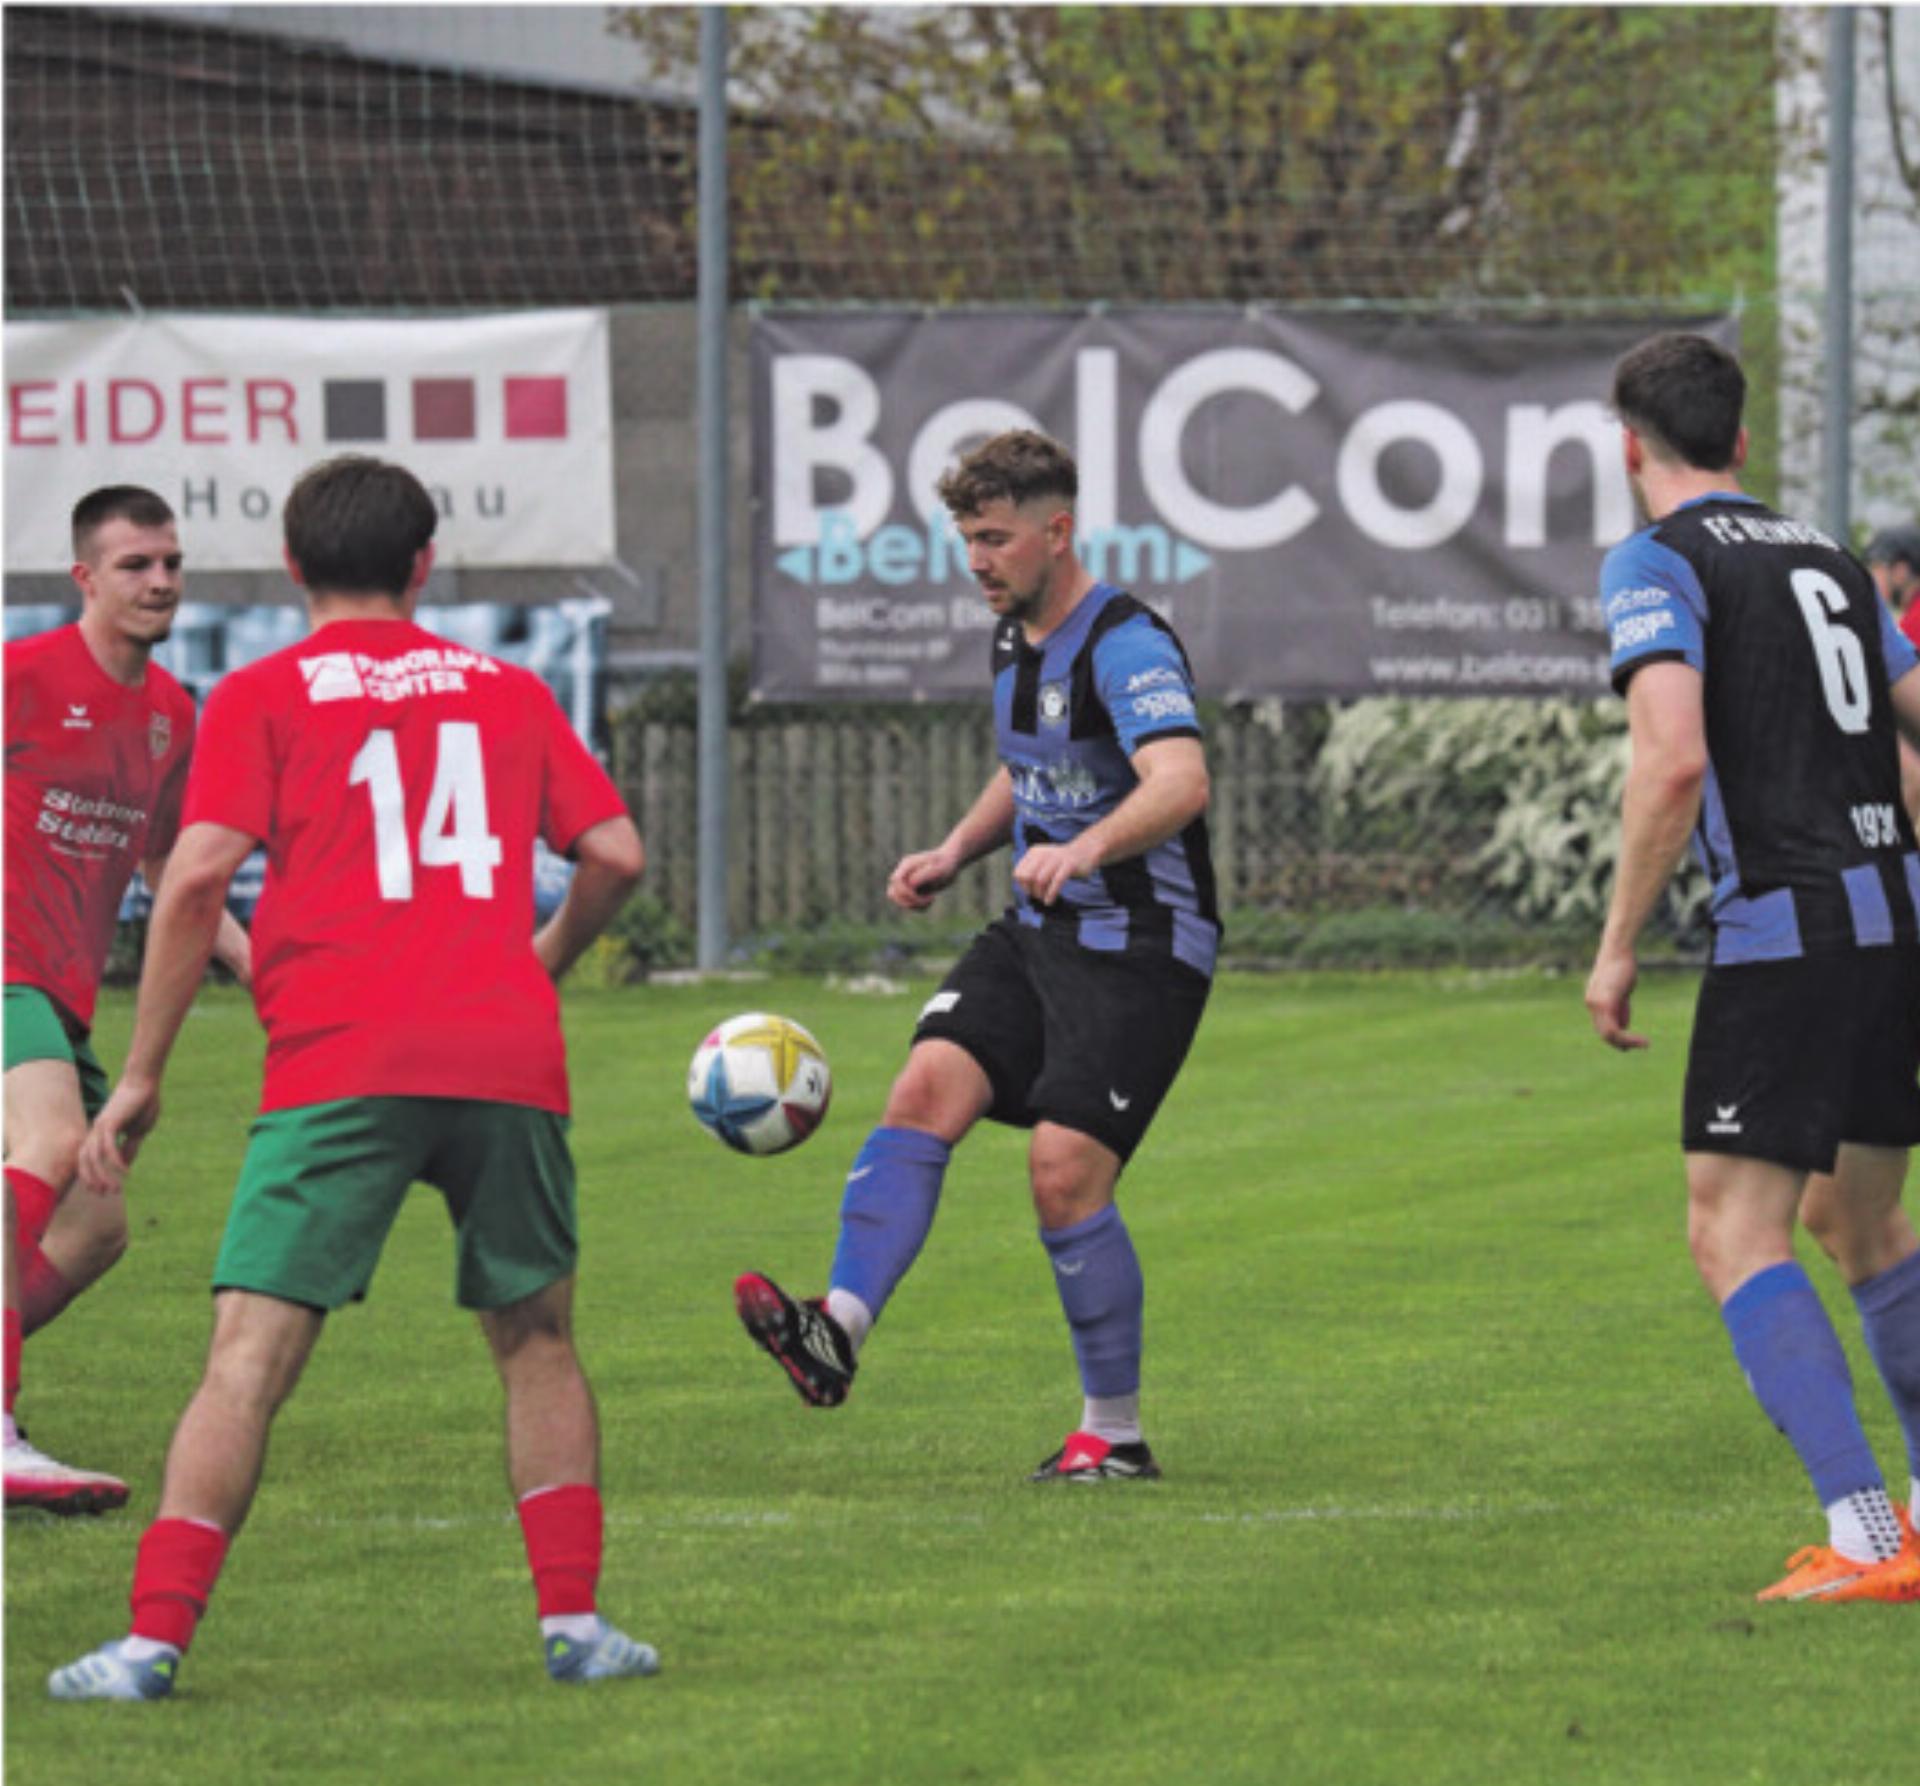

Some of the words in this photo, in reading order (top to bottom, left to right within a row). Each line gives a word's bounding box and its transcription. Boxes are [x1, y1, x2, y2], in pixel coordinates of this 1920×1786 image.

[9, 378, 298, 446] EIDER
[185, 476, 506, 519] Hoau
[816, 508, 1170, 585] Belm
[363, 671, 468, 702] CENTER
[1790, 568, 1871, 734] 6
[347, 720, 503, 902] 14
